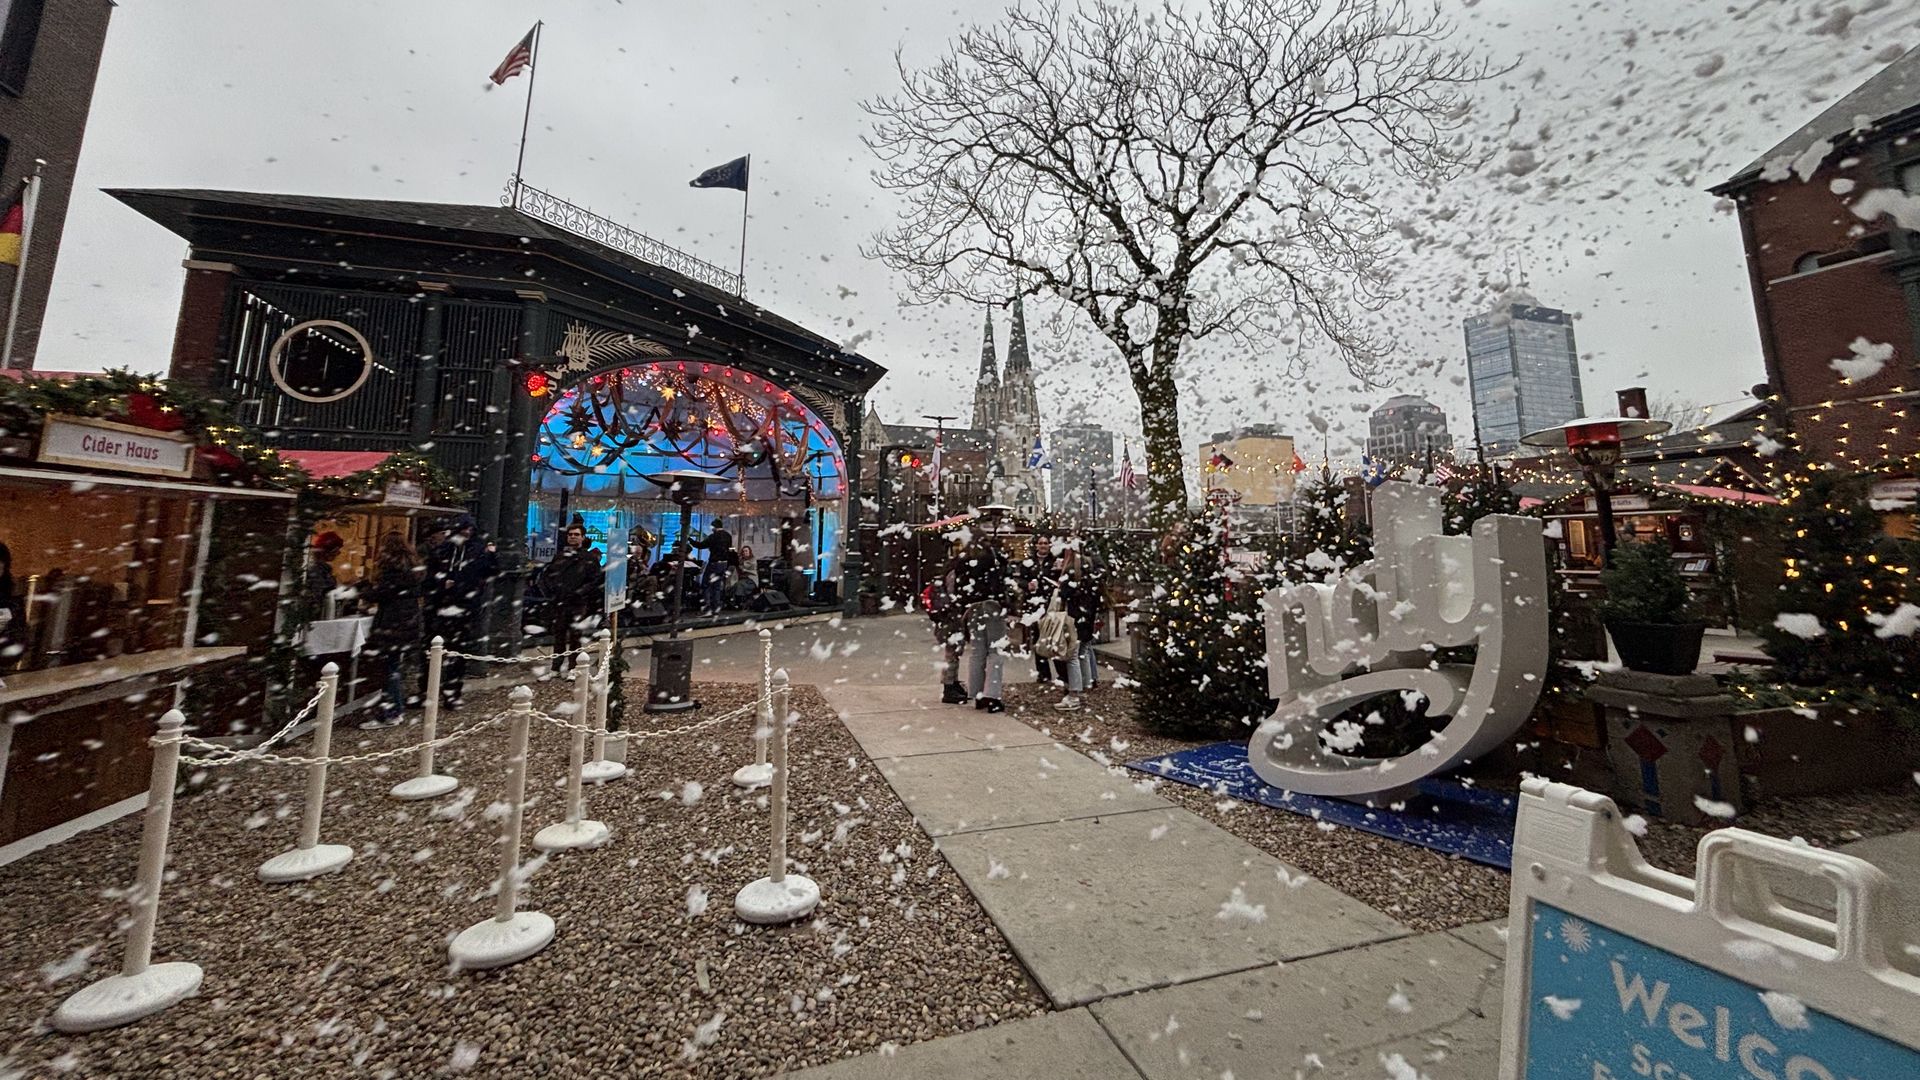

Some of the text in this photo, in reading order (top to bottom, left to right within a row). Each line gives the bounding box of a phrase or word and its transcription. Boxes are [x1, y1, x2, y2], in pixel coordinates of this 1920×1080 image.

[82, 434, 159, 460] Cider Haus
[1610, 959, 1848, 1080] Welco
